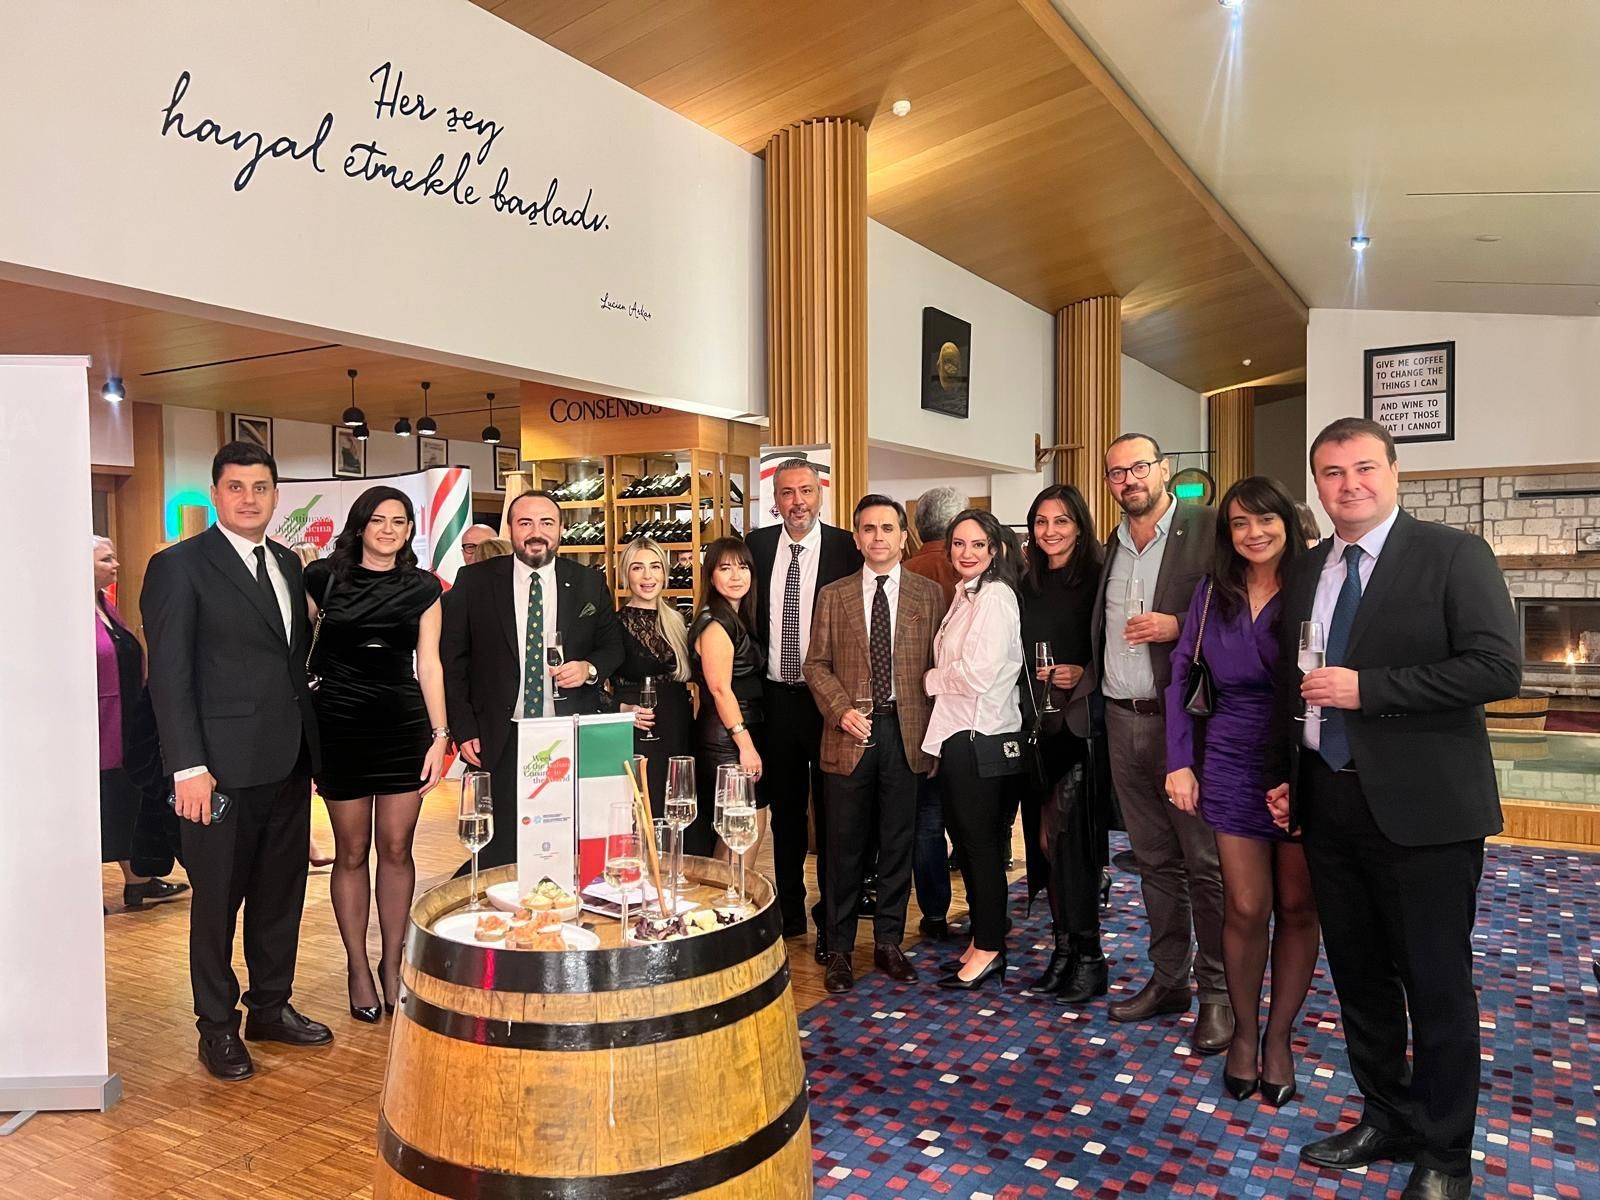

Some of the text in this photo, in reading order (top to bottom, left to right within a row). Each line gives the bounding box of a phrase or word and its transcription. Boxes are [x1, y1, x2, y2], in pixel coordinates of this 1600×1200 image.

[369, 61, 437, 120] Her
[161, 70, 334, 192] hayal
[343, 140, 482, 205] etmekle
[1375, 355, 1444, 369] GIVE ME COFFEE
[1376, 366, 1444, 380] TO CHANGE THE
[1381, 380, 1411, 390] THINGS
[1420, 378, 1438, 387] CAN
[1380, 399, 1438, 411] AND WINE TO
[1379, 409, 1440, 422] ACCEPT THOSE
[1407, 421, 1442, 431] CANNOT
